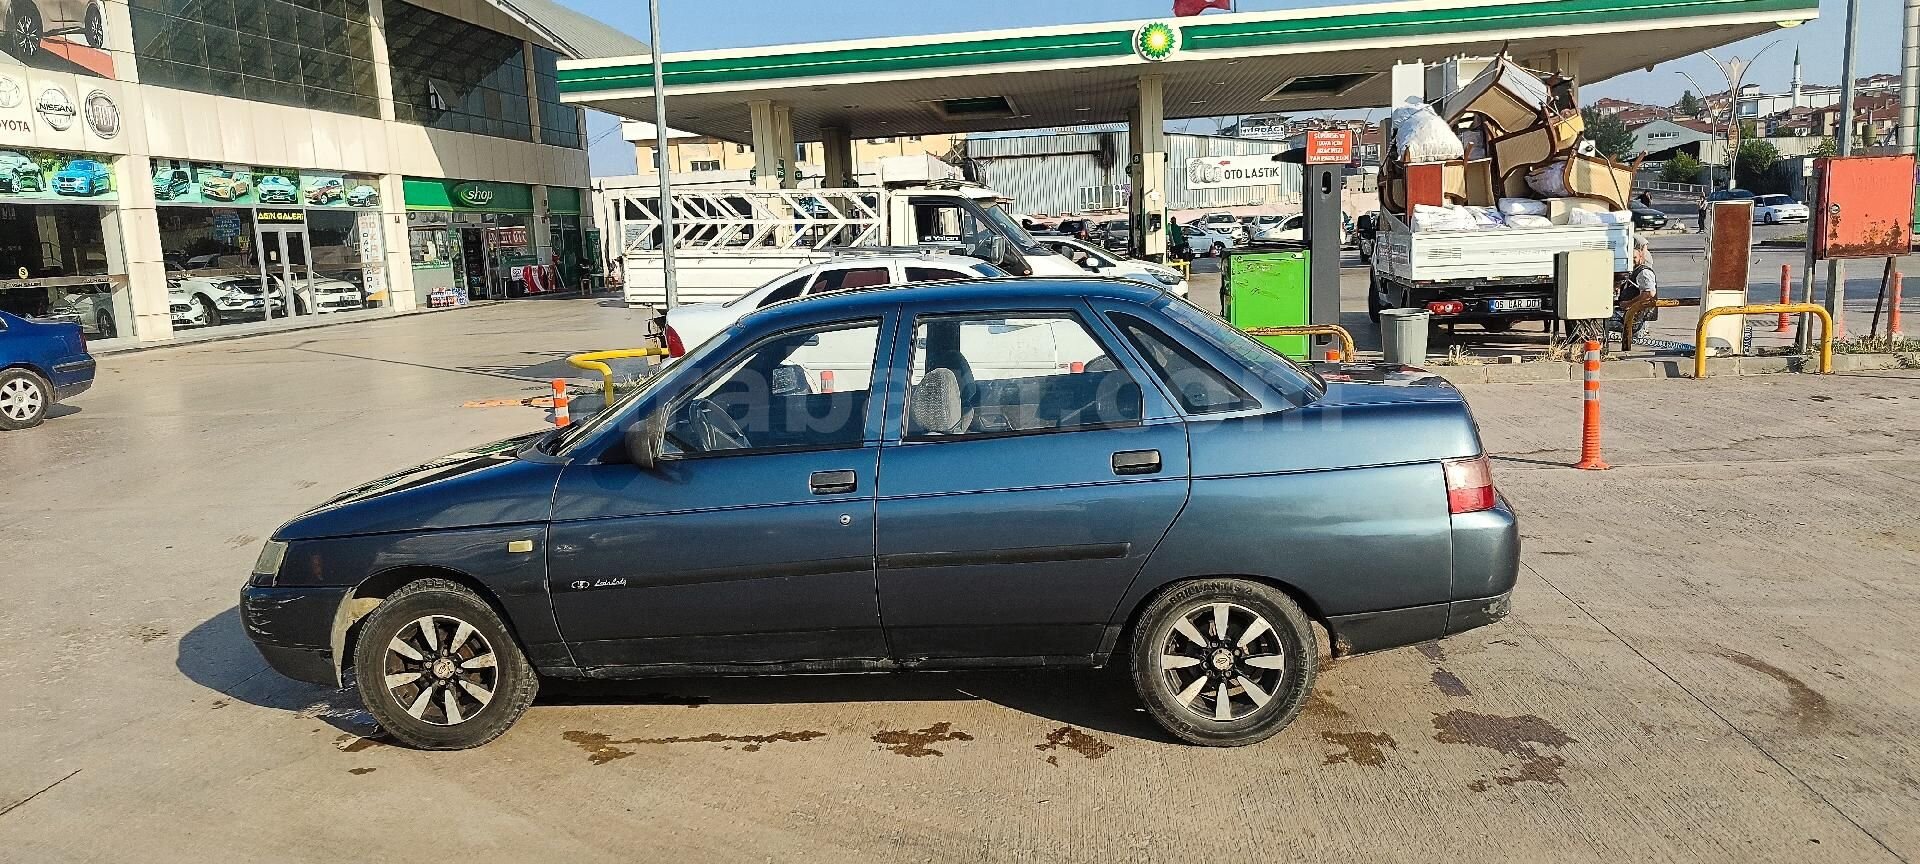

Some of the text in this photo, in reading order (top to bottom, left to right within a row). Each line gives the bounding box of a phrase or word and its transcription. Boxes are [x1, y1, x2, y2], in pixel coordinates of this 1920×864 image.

[38, 102, 73, 113] NISSAN
[0, 119, 31, 132] YOTA
[1224, 166, 1280, 180] OTO LASTİK
[468, 185, 493, 204] shop
